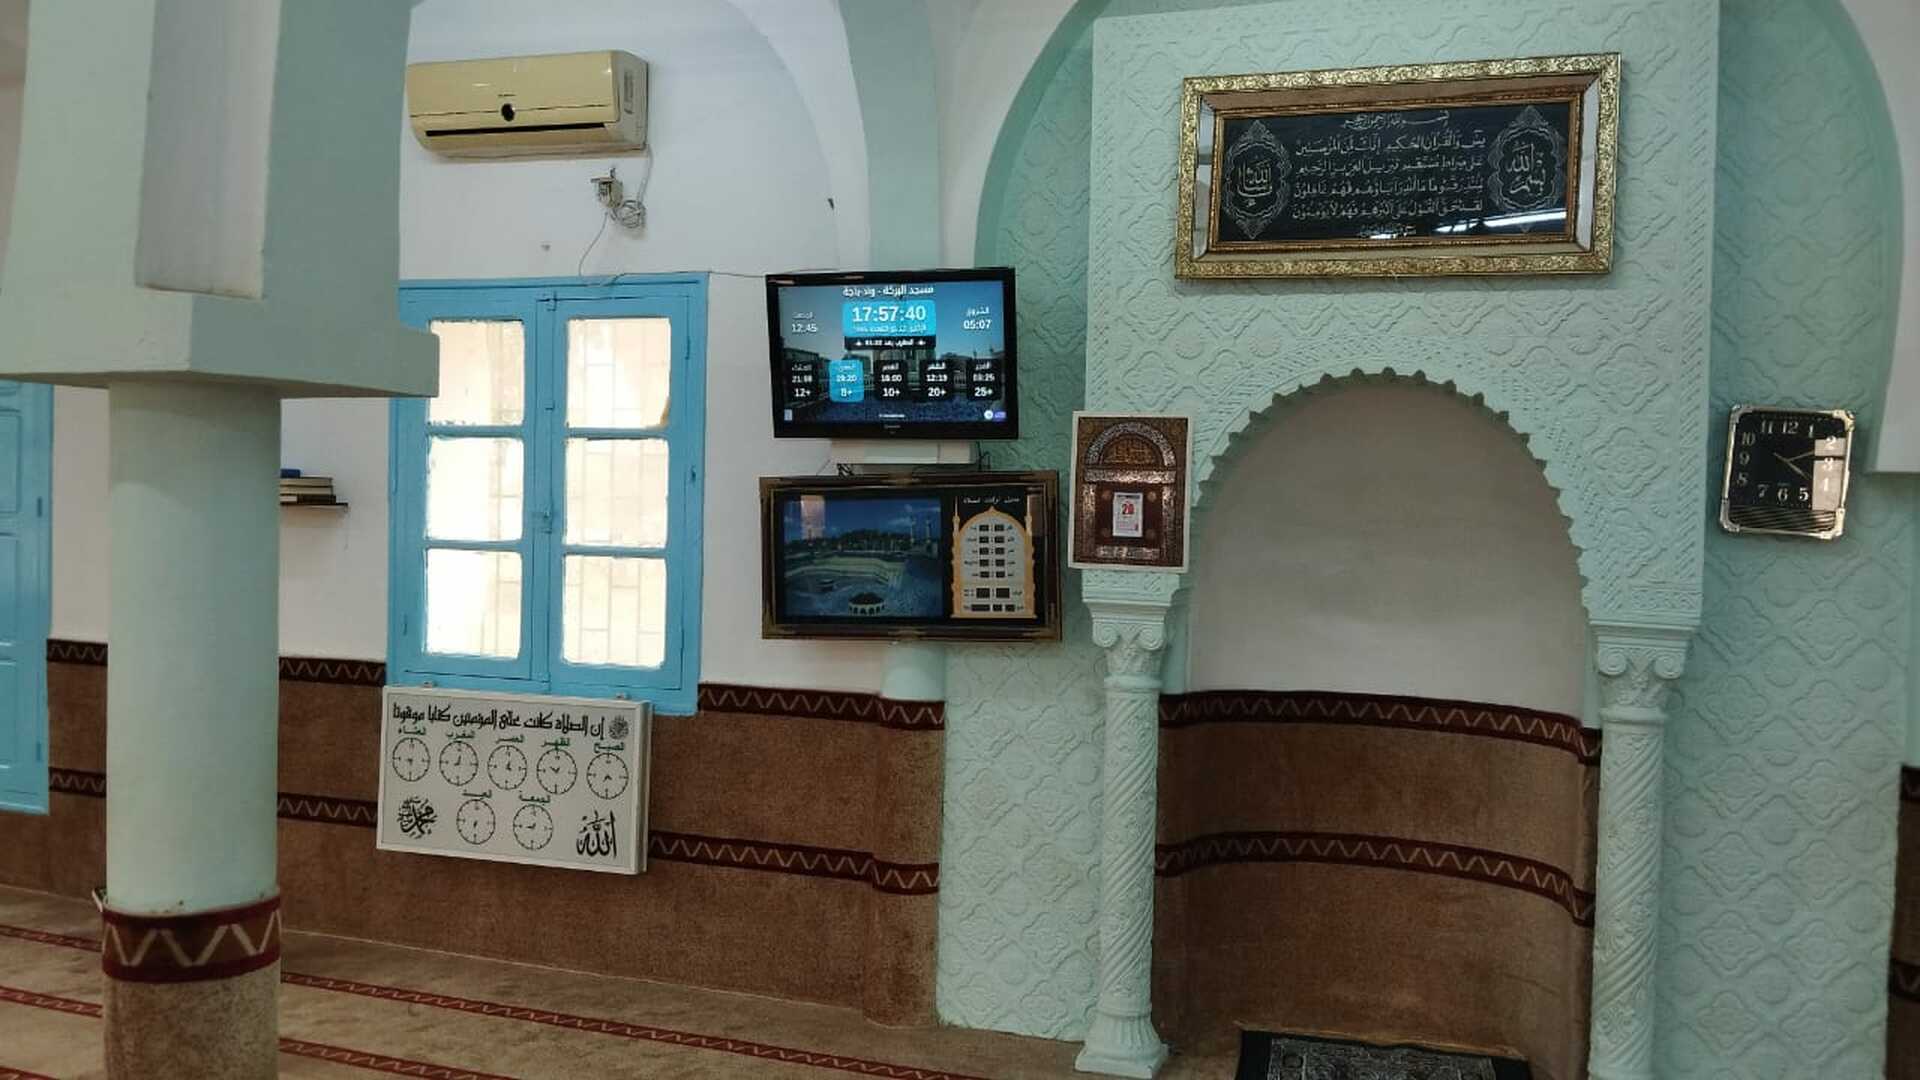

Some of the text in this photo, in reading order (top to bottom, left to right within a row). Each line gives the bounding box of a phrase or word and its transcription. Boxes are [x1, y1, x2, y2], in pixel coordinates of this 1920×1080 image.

[852, 305, 927, 322] 17:57:40
[963, 319, 992, 330] 05:07
[794, 387, 811, 397] 12+
[882, 387, 901, 397] 10+
[927, 387, 947, 397] 20+
[1761, 420, 1774, 434] 11
[1782, 420, 1799, 434] 12
[1808, 424, 1815, 438] 1
[1741, 432, 1756, 446] 10
[1825, 435, 1837, 450] 2
[1739, 452, 1750, 465] 9
[1757, 484, 1769, 498] 7
[1777, 487, 1788, 501] 6
[1799, 487, 1810, 501] 5
[393, 702, 425, 725] موقوتا
[428, 704, 452, 724] كتابا
[453, 709, 498, 731] المؤمنين
[498, 711, 522, 730] على
[523, 711, 554, 730] كانت
[576, 809, 617, 859] الله
